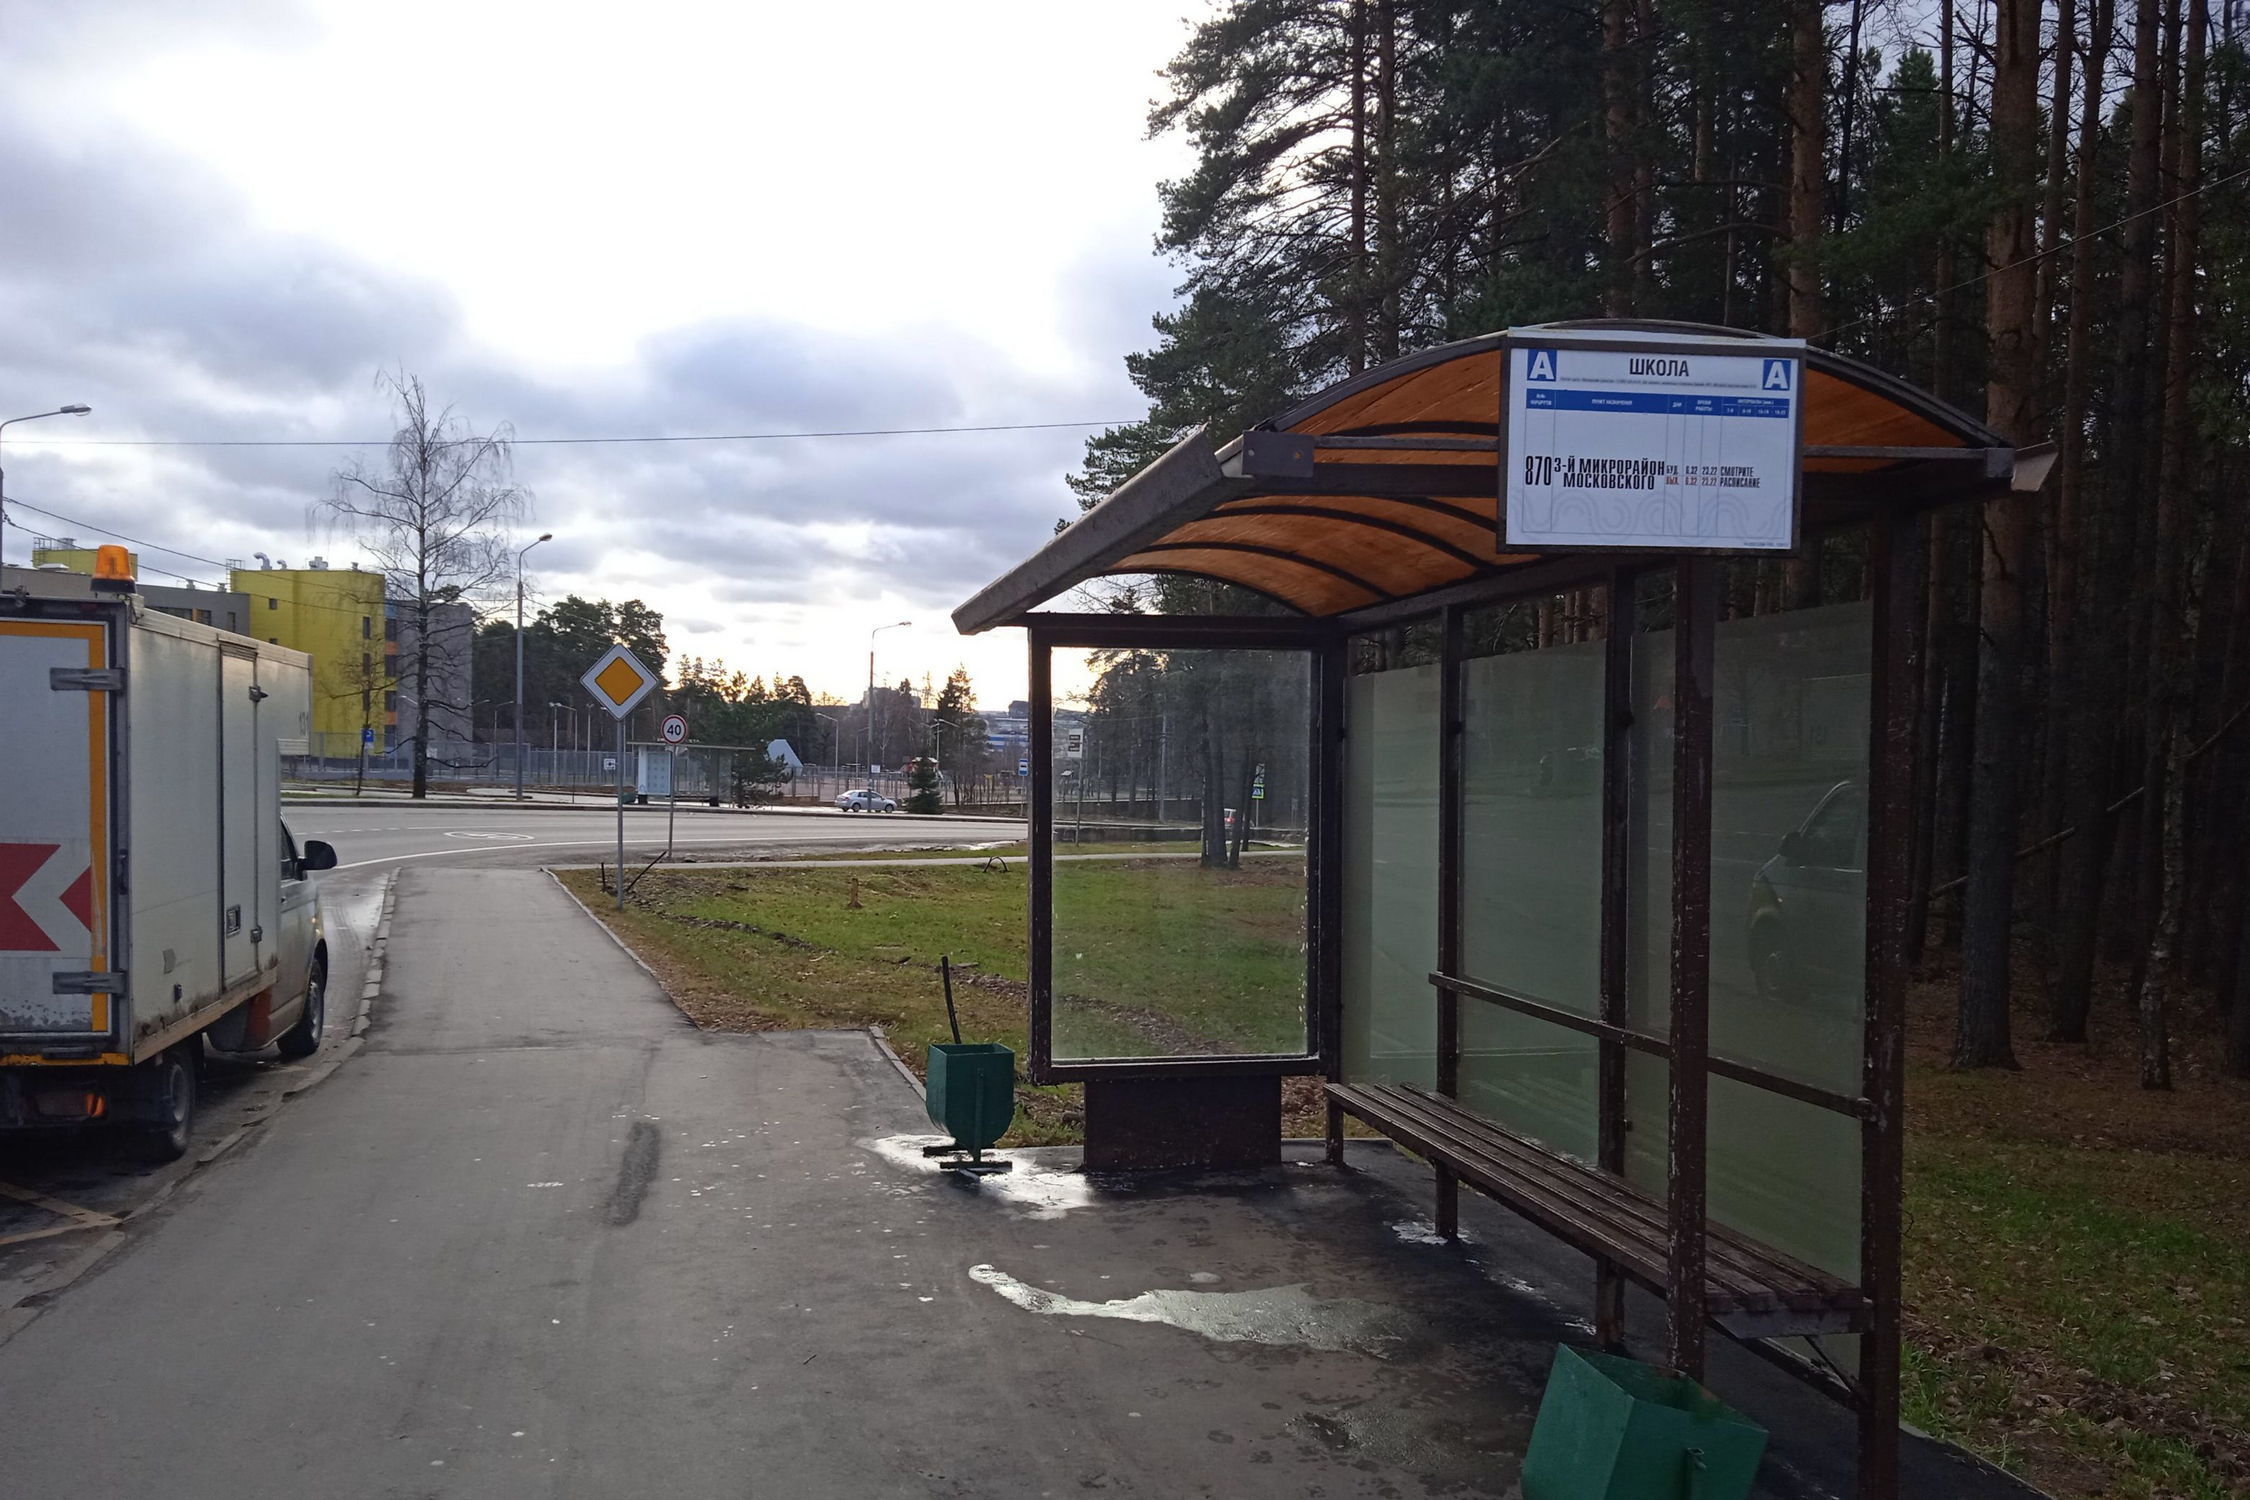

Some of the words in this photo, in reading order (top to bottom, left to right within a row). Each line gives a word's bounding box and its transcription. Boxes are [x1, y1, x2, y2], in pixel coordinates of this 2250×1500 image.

[1529, 352, 1554, 379] А
[1629, 358, 1690, 377] ШКОЛА
[1764, 361, 1788, 388] А
[1525, 455, 1552, 486] 870
[1554, 455, 1575, 473] 3-Й
[1579, 457, 1665, 476] МИКРОРАЙОН
[1563, 472, 1655, 490] МОСКОВСКОГО
[667, 724, 681, 736] 40
